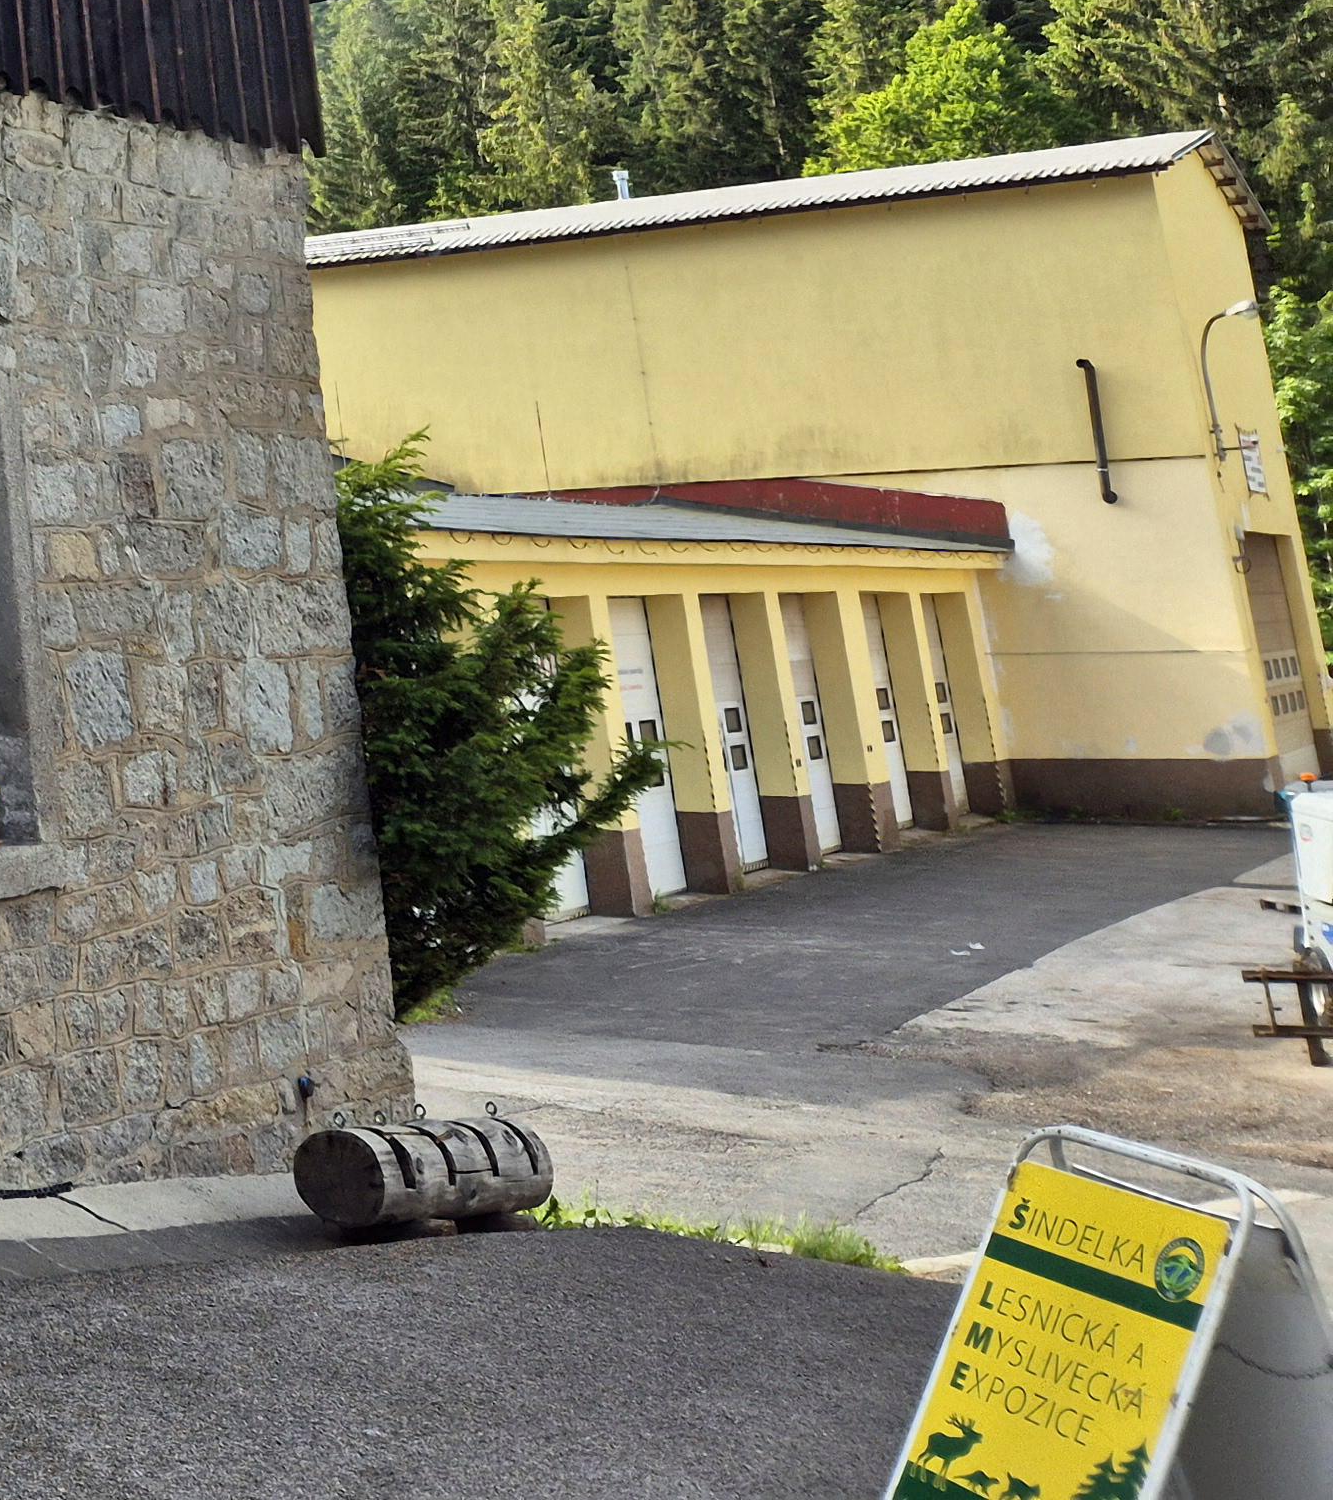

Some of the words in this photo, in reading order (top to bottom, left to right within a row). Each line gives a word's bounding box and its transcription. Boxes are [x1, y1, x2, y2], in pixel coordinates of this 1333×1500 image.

[1008, 1197, 1145, 1274] ŠINDELKA
[979, 1280, 1121, 1352] LESNICKÁ
[1127, 1342, 1144, 1369] A
[949, 1362, 1095, 1446] EXPOZICE
[964, 1320, 1145, 1419] MYSLIVECKÁ
